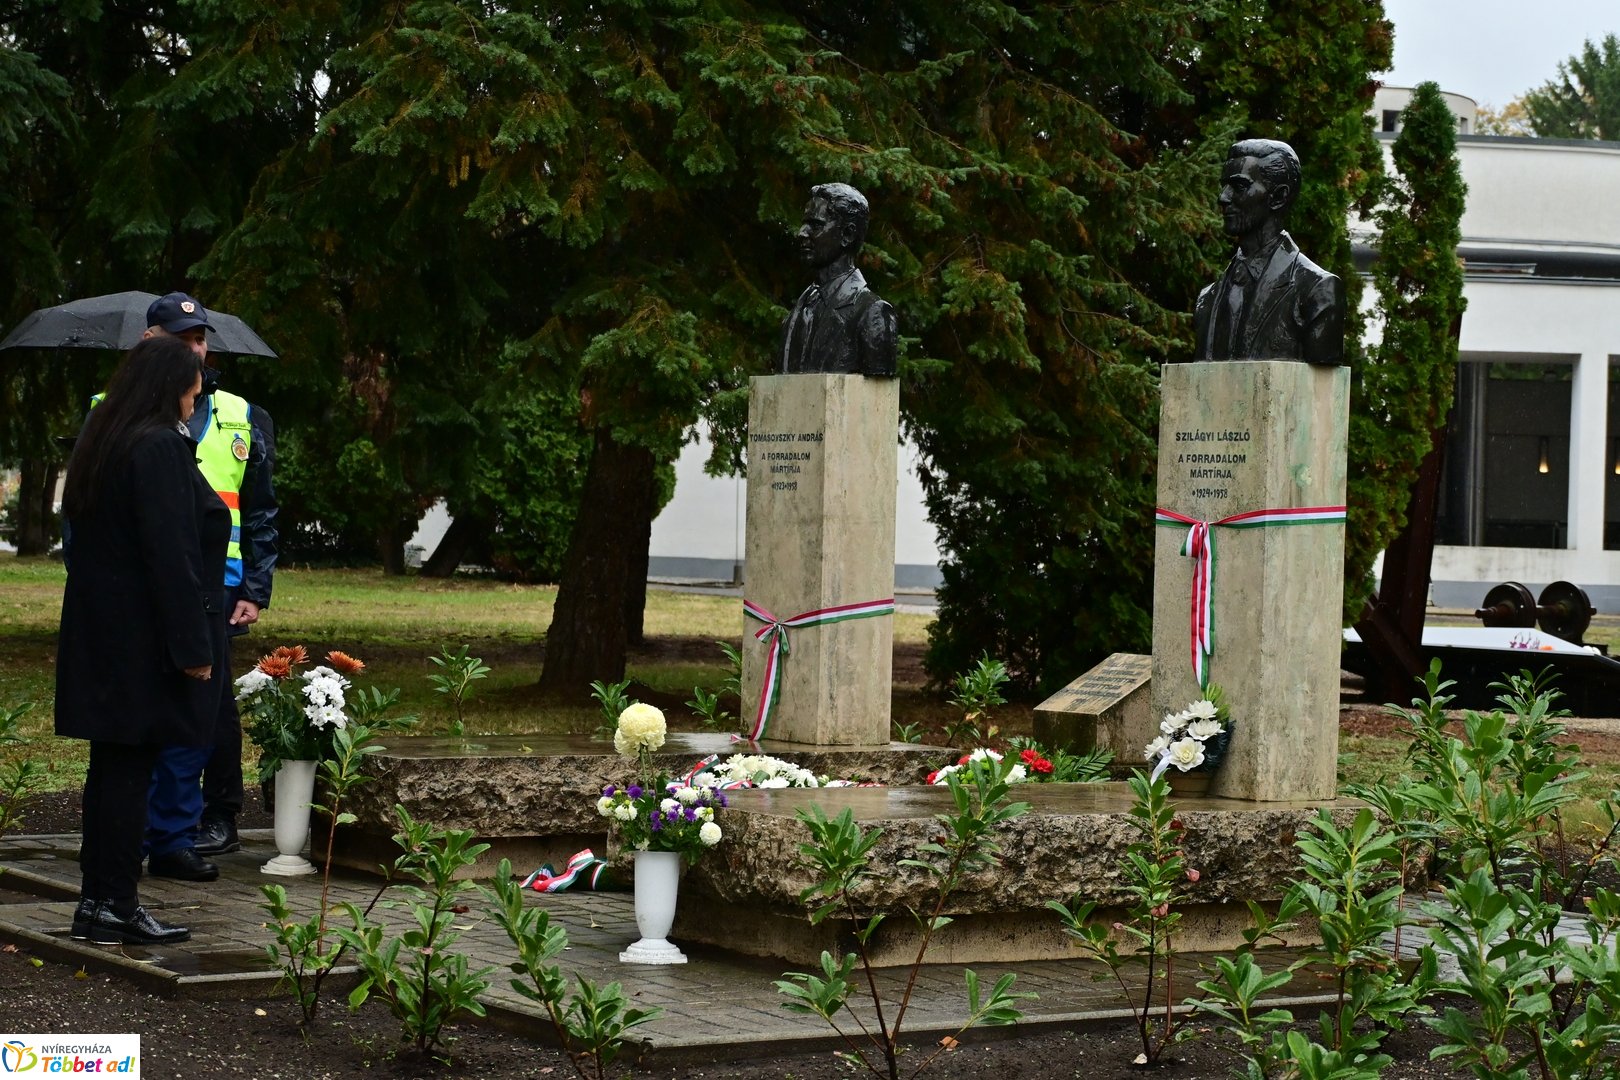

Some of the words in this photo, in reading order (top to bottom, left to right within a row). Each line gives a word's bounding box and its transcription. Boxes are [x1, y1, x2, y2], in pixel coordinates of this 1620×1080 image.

[798, 430, 824, 442] ANDRÁS
[1176, 429, 1214, 441] SZILÁGYI
[1217, 428, 1250, 441] LÁSZLÓ
[768, 452, 810, 460] FORRADALOM
[1178, 454, 1184, 463] A
[1186, 454, 1246, 463] FORRADALOM
[770, 464, 800, 473] MÁRTÍRJA
[1190, 467, 1232, 478] MÁRTÍRJA
